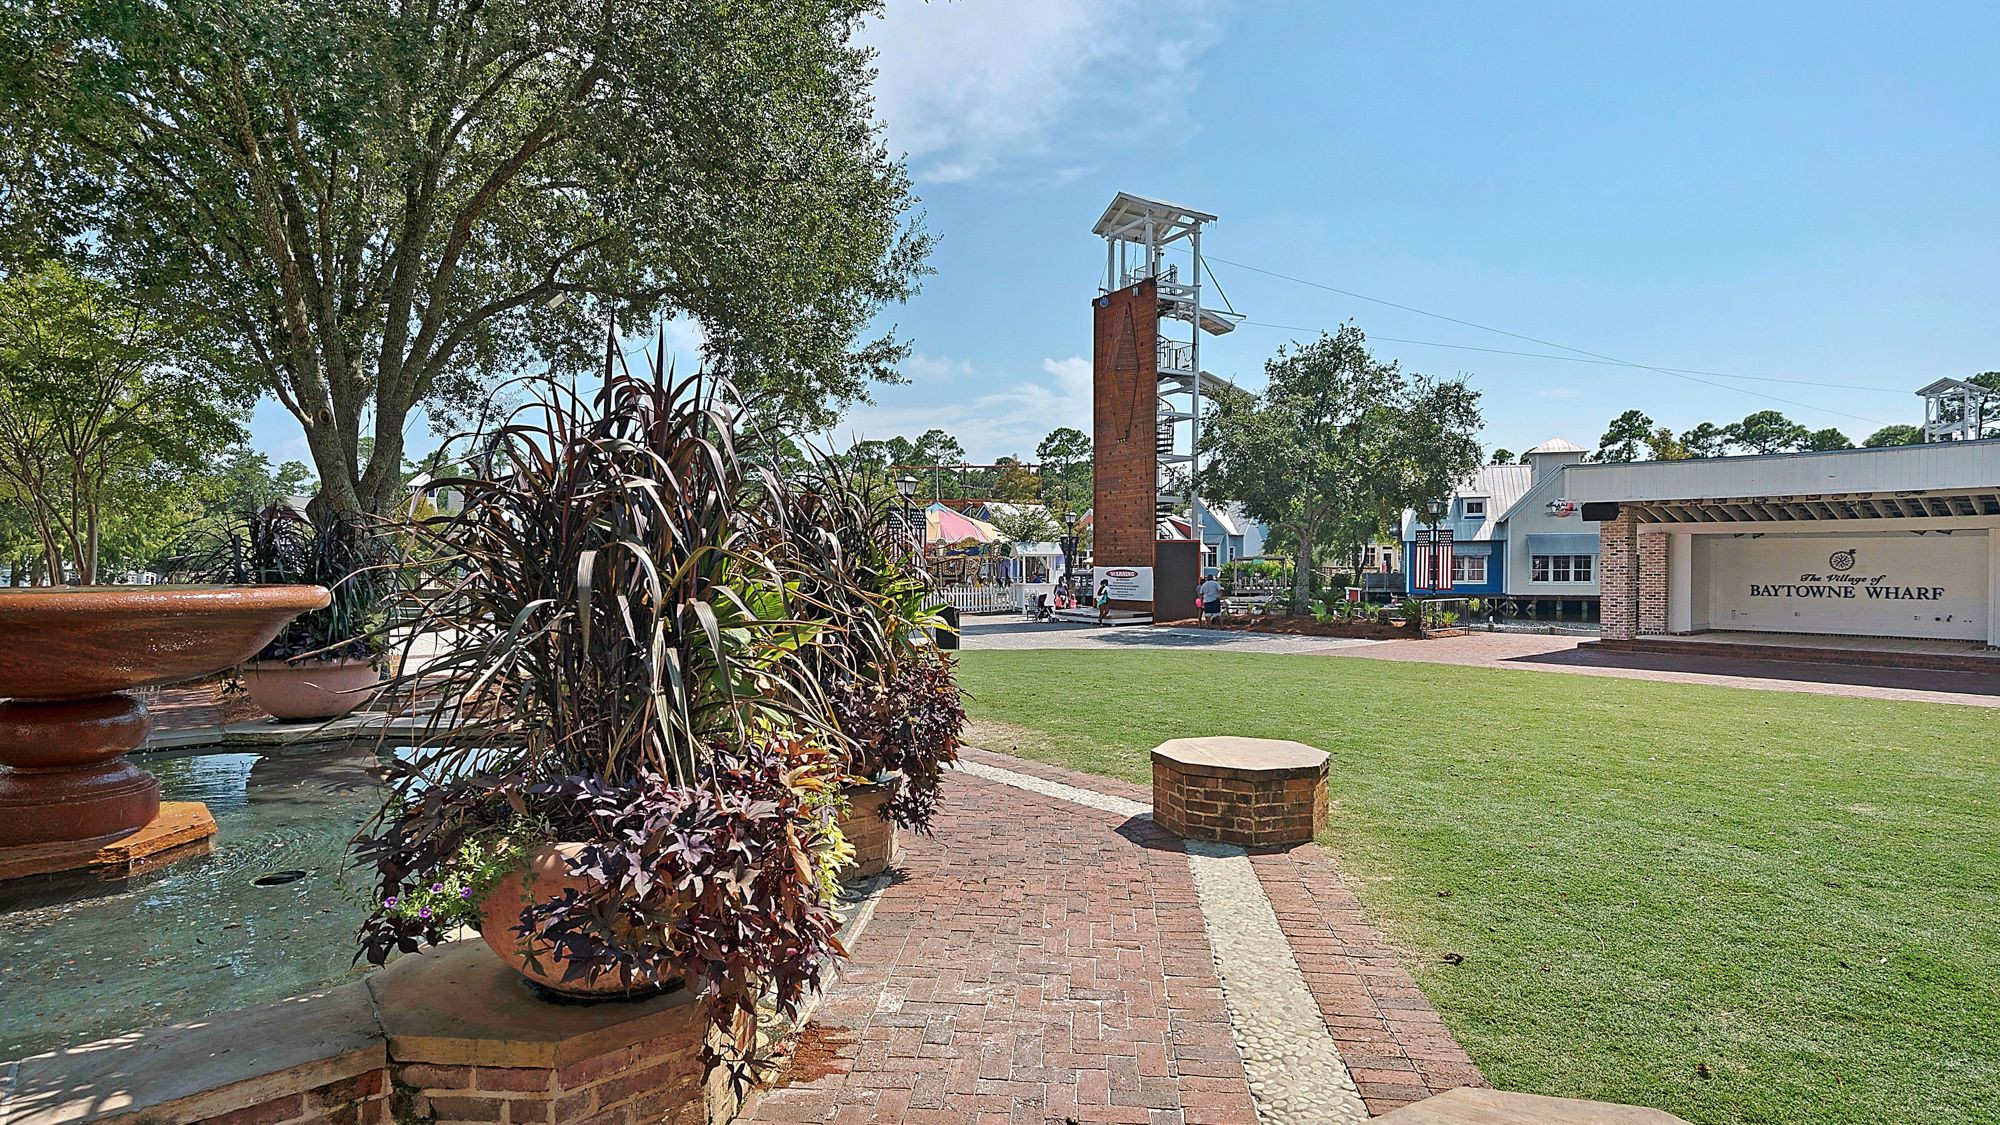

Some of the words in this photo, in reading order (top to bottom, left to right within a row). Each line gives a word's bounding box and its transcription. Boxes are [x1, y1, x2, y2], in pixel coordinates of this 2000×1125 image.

[1800, 574, 1821, 583] The
[1826, 574, 1867, 586] Village
[1870, 574, 1887, 584] of
[1750, 584, 1855, 599] BAYTOWNE
[1864, 586, 1945, 601] WHARF
